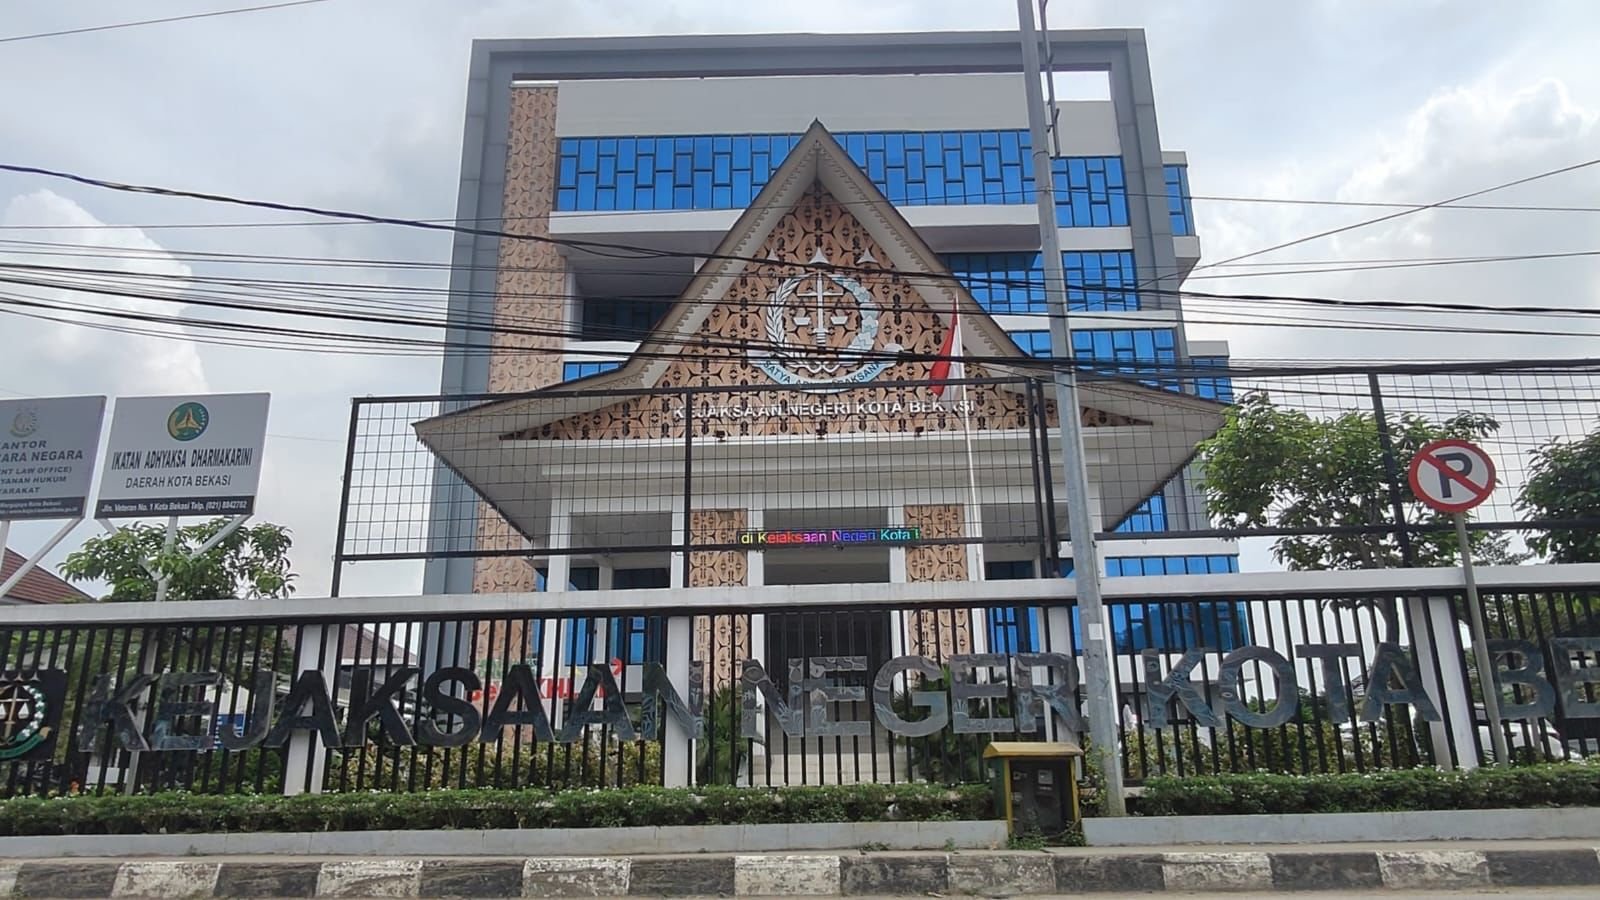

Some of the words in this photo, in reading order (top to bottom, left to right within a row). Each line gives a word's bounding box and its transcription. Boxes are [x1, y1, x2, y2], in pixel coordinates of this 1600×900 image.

[763, 360, 791, 383] SATYA
[787, 402, 850, 416] NEGERI
[856, 401, 902, 415] KOTA
[910, 400, 974, 413] BEKSI
[0, 440, 47, 450] ANTOR
[0, 452, 27, 463] ARA
[31, 450, 83, 462] NEGARA
[111, 451, 143, 470] IKATAN
[144, 449, 187, 469] ADHYAKSA
[191, 448, 253, 467] DHARMAKARINI
[16, 467, 35, 475] LAW
[37, 466, 72, 474] OFFICE)
[1436, 452, 1472, 498] P
[125, 476, 165, 488] DAERAH
[167, 475, 192, 488] KOTA
[195, 474, 231, 487] BEKASI
[154, 502, 169, 511] Kota
[169, 501, 190, 511] Bekasi
[740, 531, 753, 544] di
[880, 528, 911, 541] Kota
[77, 663, 704, 752] KEJAKSAAN
[741, 652, 1090, 738] NEGER
[1141, 641, 1441, 729] KOTA
